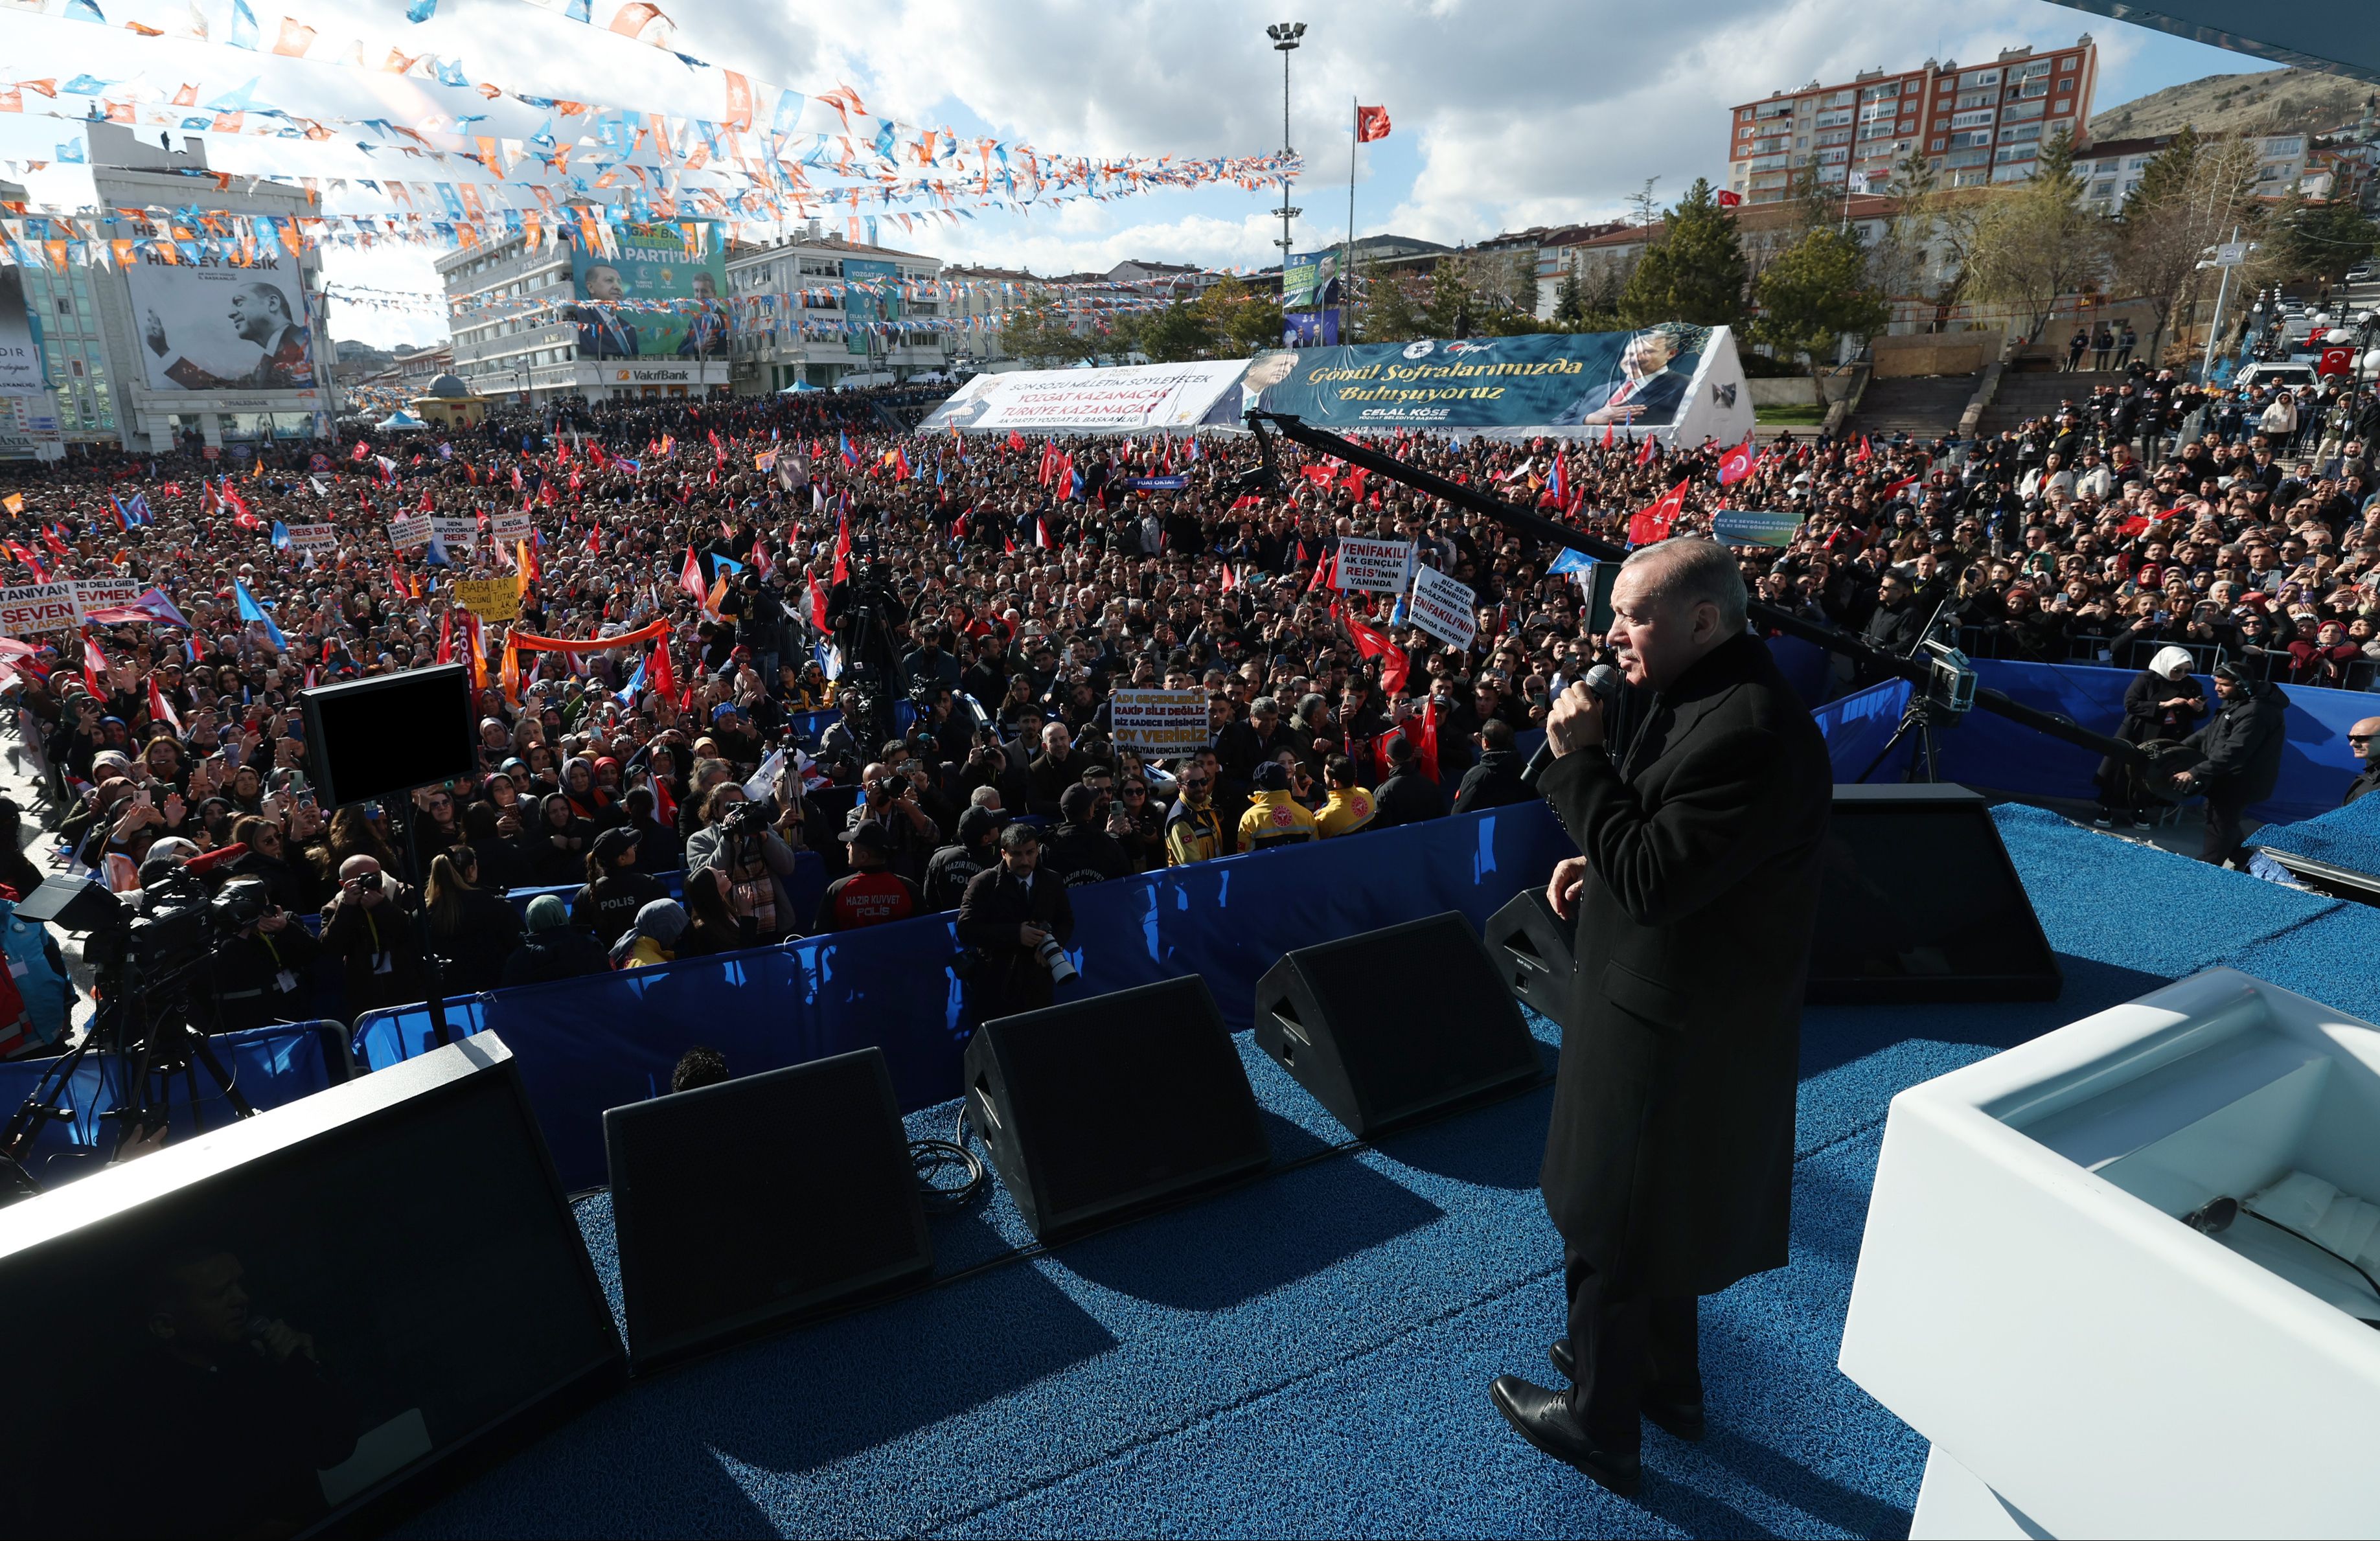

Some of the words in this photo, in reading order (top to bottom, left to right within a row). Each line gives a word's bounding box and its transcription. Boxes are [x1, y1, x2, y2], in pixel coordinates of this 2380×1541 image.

[1306, 363, 1381, 385] Gönül
[1380, 358, 1584, 383] Sofralarımızda
[1009, 383, 1036, 391] SON
[1017, 392, 1074, 403] YOZGAT
[1338, 385, 1506, 405] Buluşuyoruz
[1001, 404, 1060, 417] TÜRKİYE
[1409, 407, 1450, 417] KÖSE
[502, 518, 523, 527] DEĞİL
[314, 526, 330, 535] BU
[395, 531, 434, 547] EMANET
[1342, 542, 1407, 559] YENİFAKILI
[1360, 558, 1402, 569] GENÇLİK
[460, 578, 509, 594] BABALAR
[1350, 577, 1392, 588] YANINDA
[1440, 578, 1455, 589] BİZ
[0, 584, 70, 602] TANIYAN
[76, 589, 137, 602] EVMEK
[493, 591, 516, 602] TUTAR
[1417, 584, 1457, 610] BOĞAZINDA
[3, 602, 74, 624] SEVEN
[1413, 593, 1474, 635] ENİFAKILI'NIN
[5, 622, 25, 634] NE
[25, 615, 78, 631] YAPSIN
[1411, 610, 1437, 630] YAZINDA
[1439, 626, 1466, 645] SEVDİK
[1114, 694, 1134, 704] ADI
[1135, 694, 1206, 705] GEÇENLERLE
[1114, 705, 1143, 715] RAKİP
[1145, 704, 1167, 716] BİLE
[1167, 704, 1206, 716] DEĞİLİZ
[1114, 717, 1128, 726] BİZ
[1129, 718, 1163, 727] SADECE
[1163, 717, 1207, 727] REİSİMİZE
[1116, 728, 1138, 742] OY
[1140, 726, 1208, 744] VERİRİZ
[1116, 744, 1155, 755] BOĞAZLIYAN
[1155, 746, 1182, 756] GENÇLİK
[945, 861, 966, 873] HAZIR
[966, 861, 985, 873] KUV
[950, 873, 969, 885] POL
[1081, 868, 1105, 882] KUVVET
[600, 896, 635, 911] POLİS
[846, 896, 869, 906] HAZIR
[871, 895, 900, 905] KUVVET
[856, 905, 890, 918] POLİS
[201, 915, 207, 926] 2
